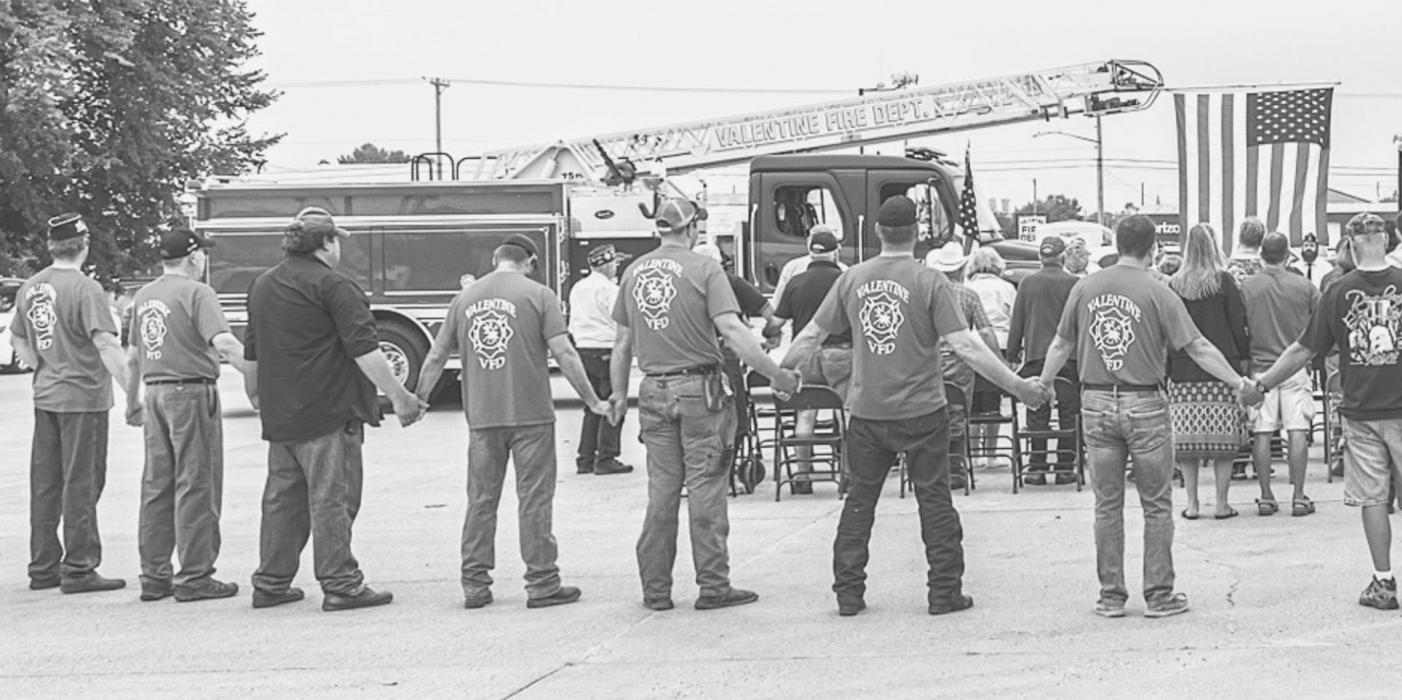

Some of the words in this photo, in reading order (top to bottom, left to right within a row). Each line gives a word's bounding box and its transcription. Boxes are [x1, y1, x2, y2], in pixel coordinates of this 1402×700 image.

[714, 115, 820, 148] VALENTINE
[825, 107, 867, 132] FIRE
[872, 99, 929, 125] DEPT.
[856, 279, 910, 304] VALENTINE
[465, 298, 517, 319] VALENTINE
[1087, 293, 1141, 323] VALENTINE
[643, 316, 669, 330] VFD
[867, 340, 896, 355] VFD
[479, 356, 505, 369] VFD
